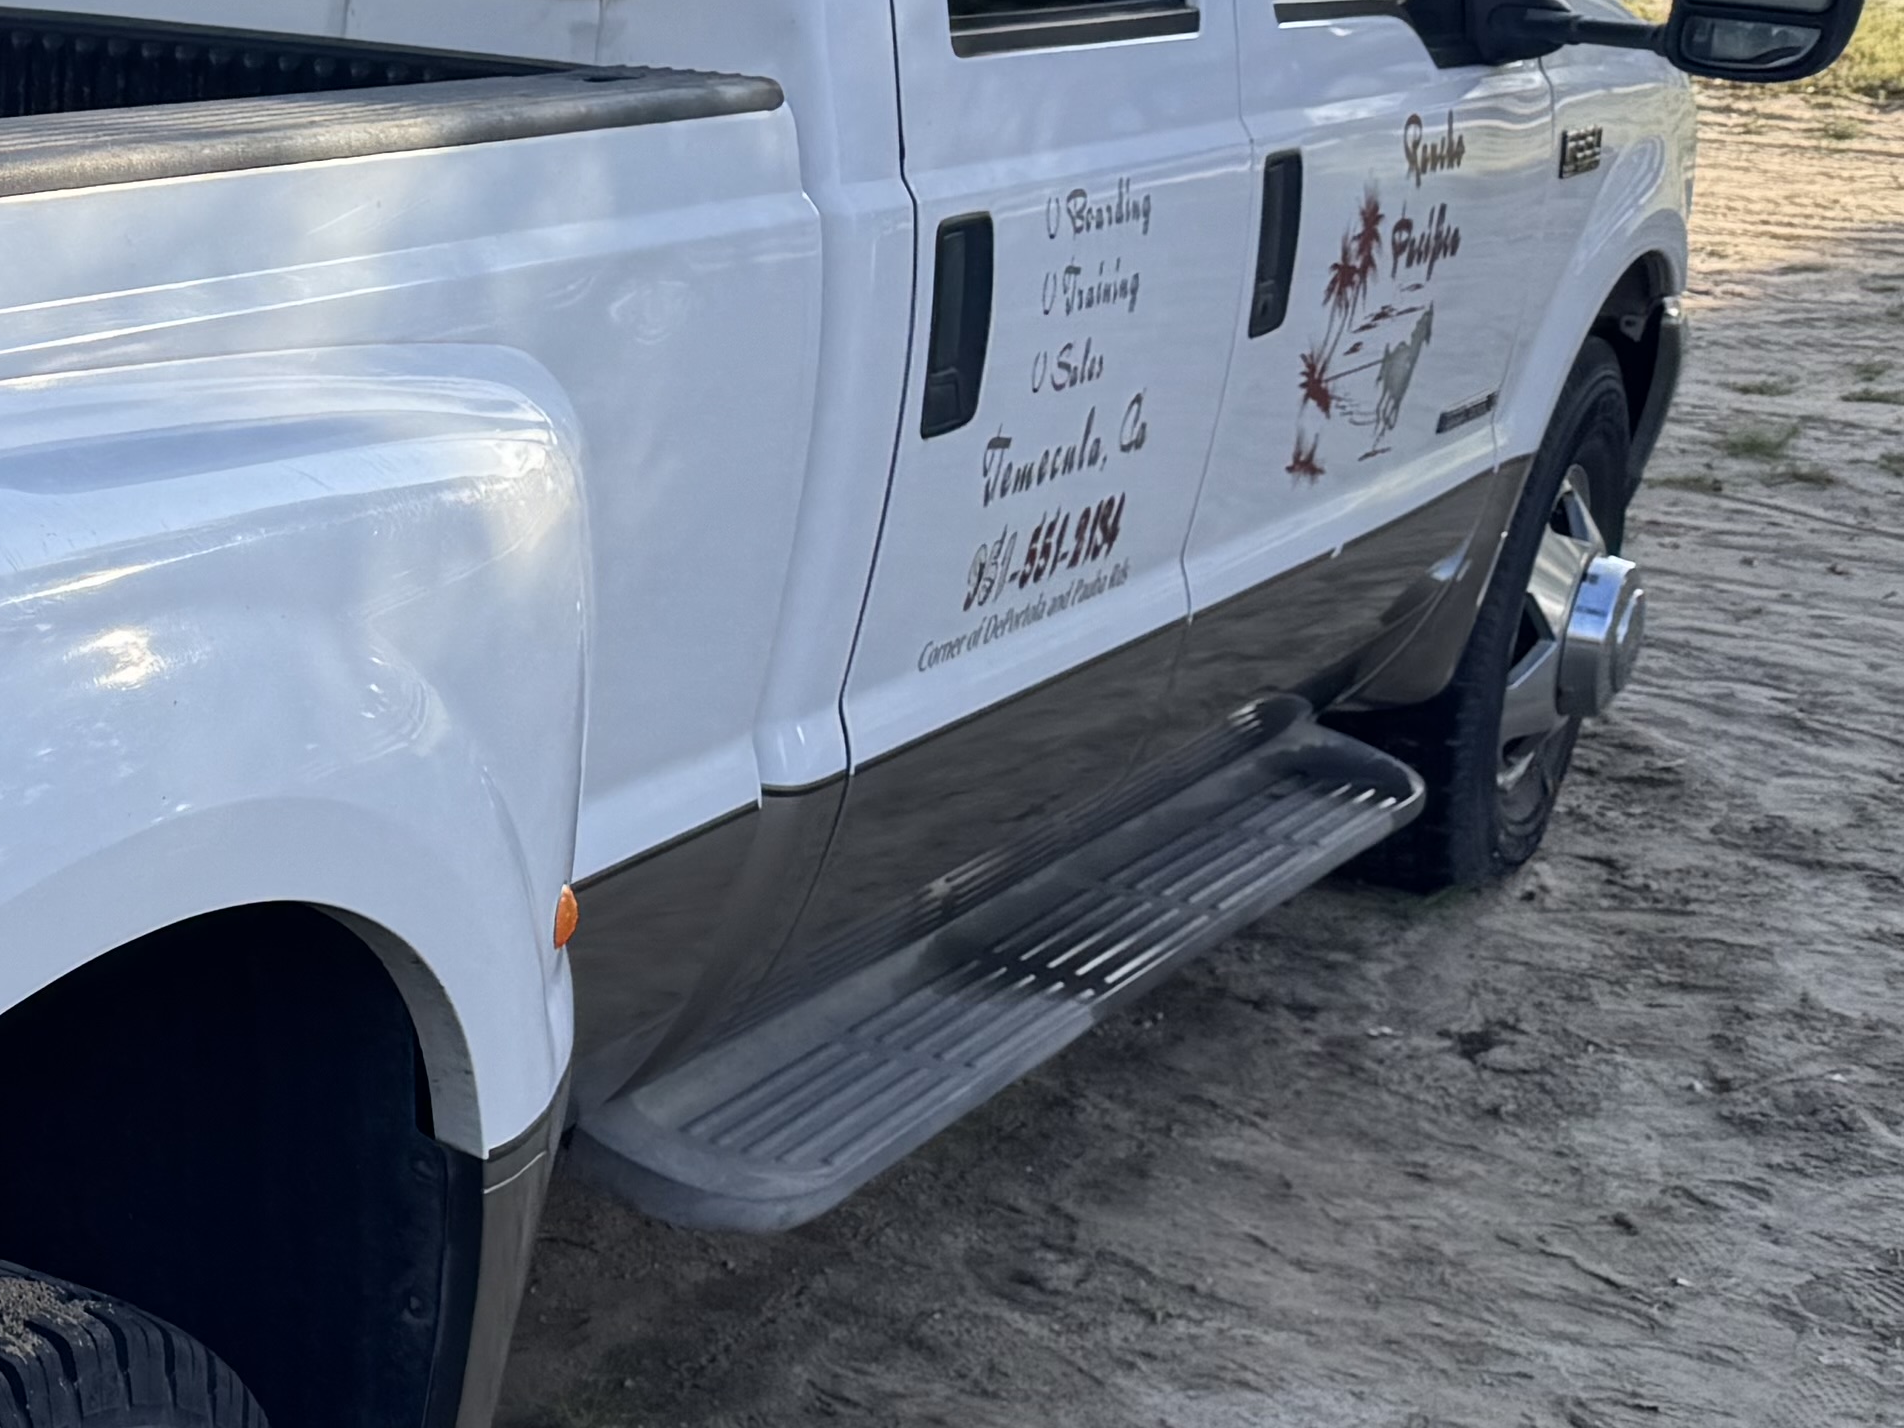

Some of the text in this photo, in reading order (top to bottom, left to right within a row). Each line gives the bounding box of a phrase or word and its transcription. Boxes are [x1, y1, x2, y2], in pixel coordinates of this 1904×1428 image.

[1065, 176, 1151, 240] Boarding
[1061, 255, 1140, 316] Training
[1050, 336, 1104, 392] Sales
[982, 405, 1108, 508] Temecula,
[917, 634, 968, 673] Corner
[966, 616, 987, 652] of
[1046, 578, 1074, 618] and
